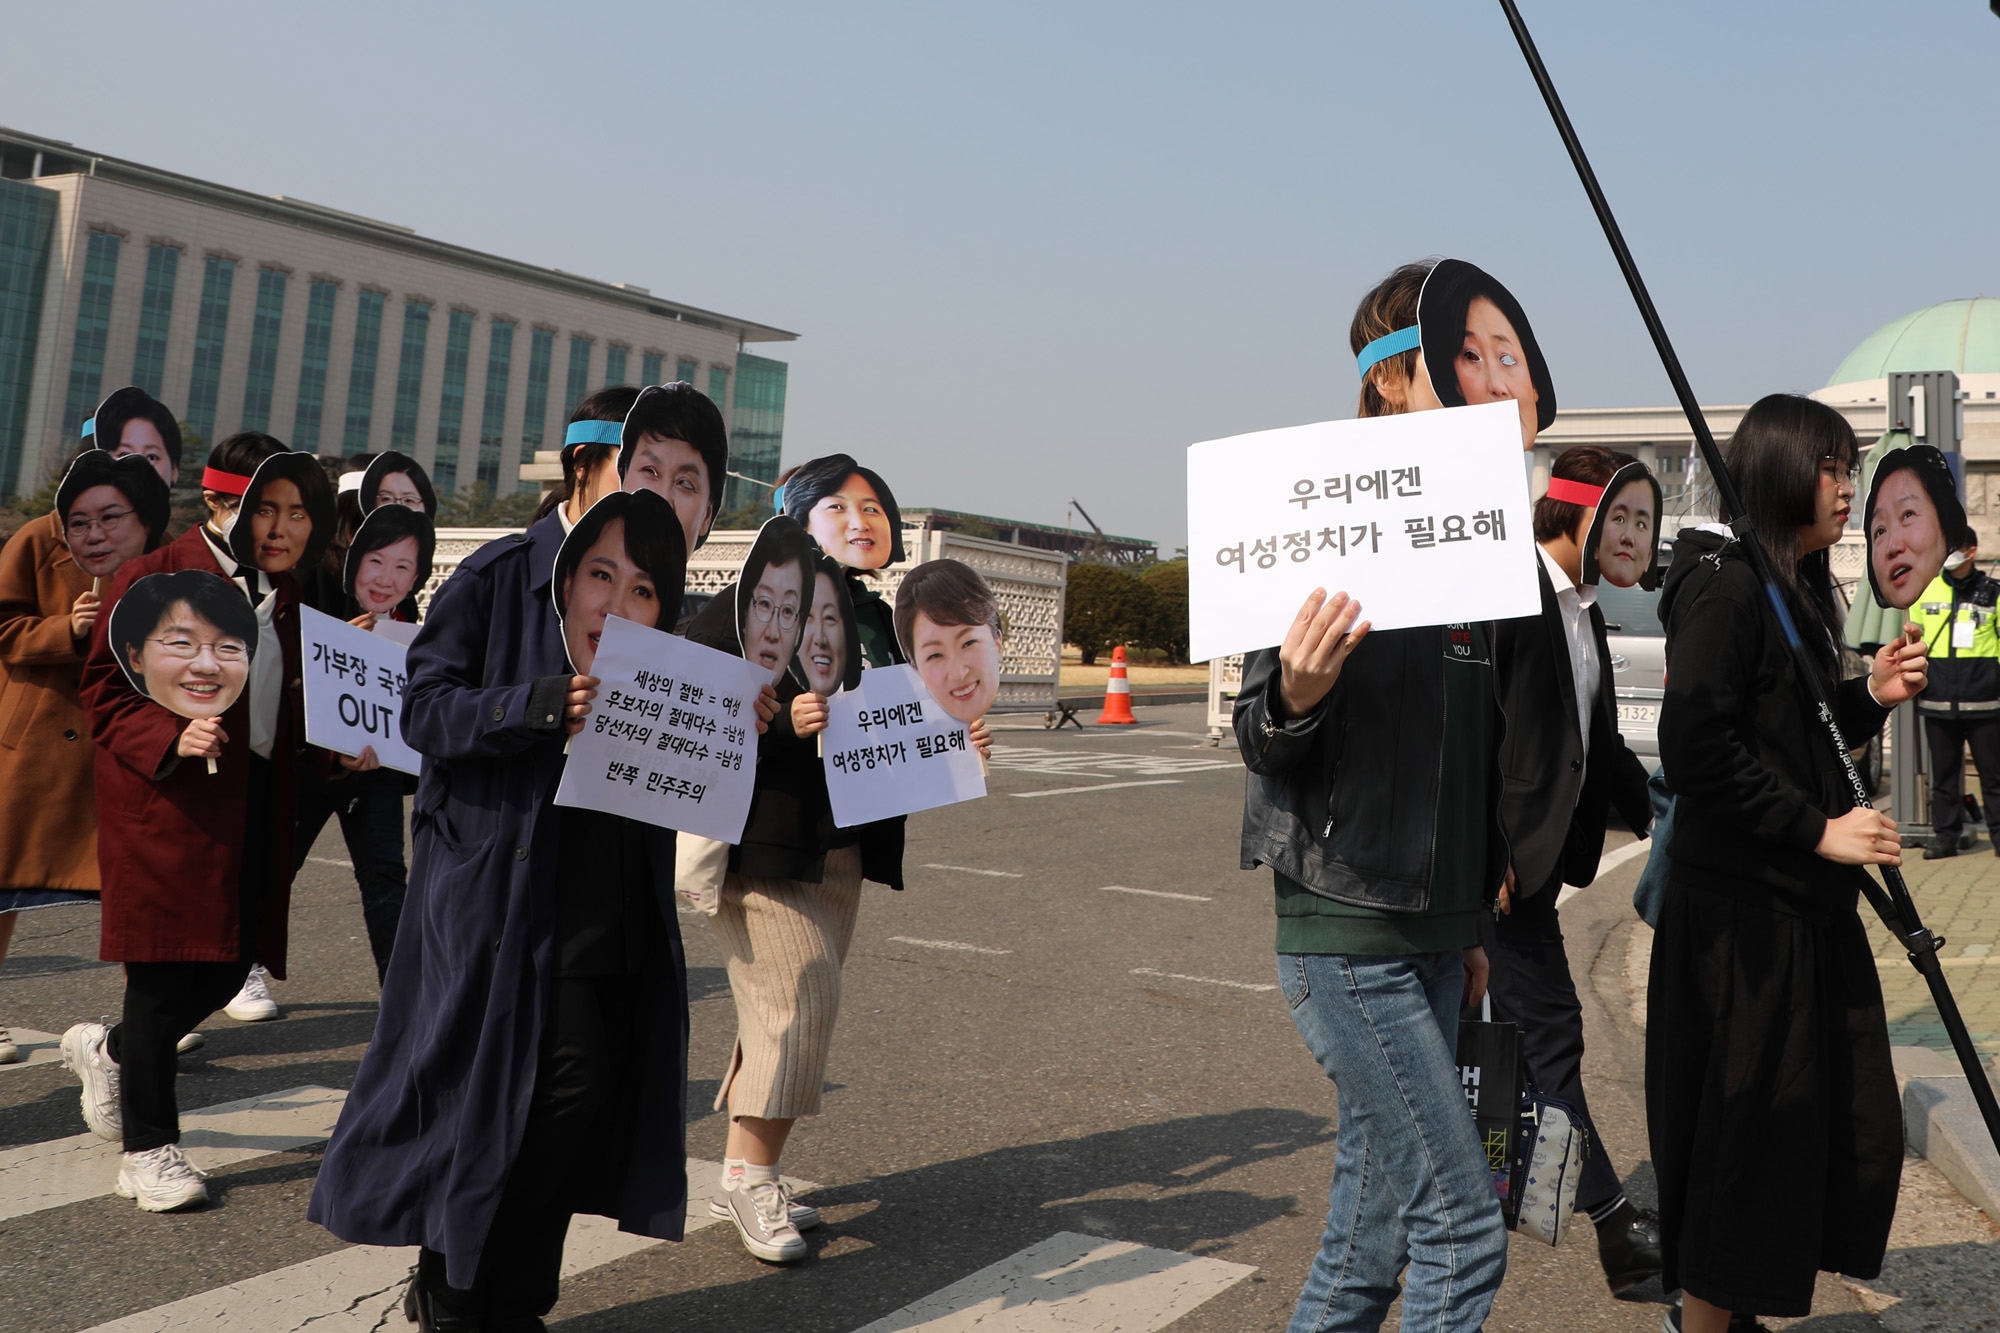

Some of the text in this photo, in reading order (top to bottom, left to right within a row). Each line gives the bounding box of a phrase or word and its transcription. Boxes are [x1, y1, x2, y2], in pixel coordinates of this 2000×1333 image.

[1907, 385, 1926, 437] 1
[1288, 465, 1423, 510] 우리에겐
[1215, 508, 1507, 574] 여성정치가 필요해
[312, 642, 367, 687] 가부장
[1452, 644, 1471, 656] YOU
[338, 693, 393, 739] OUT
[605, 690, 664, 722] 후보자의
[668, 707, 717, 737] 절대다수
[633, 670, 674, 697] 세상의
[679, 682, 704, 706] 절반
[722, 697, 742, 718] 여성
[594, 714, 653, 746] 당선자의
[656, 732, 709, 761] 절대다수
[857, 701, 924, 733] 우리에겐
[832, 729, 966, 774] 여성정치가 필요해
[606, 760, 640, 786] 반쪽
[646, 771, 707, 804] 민주주의
